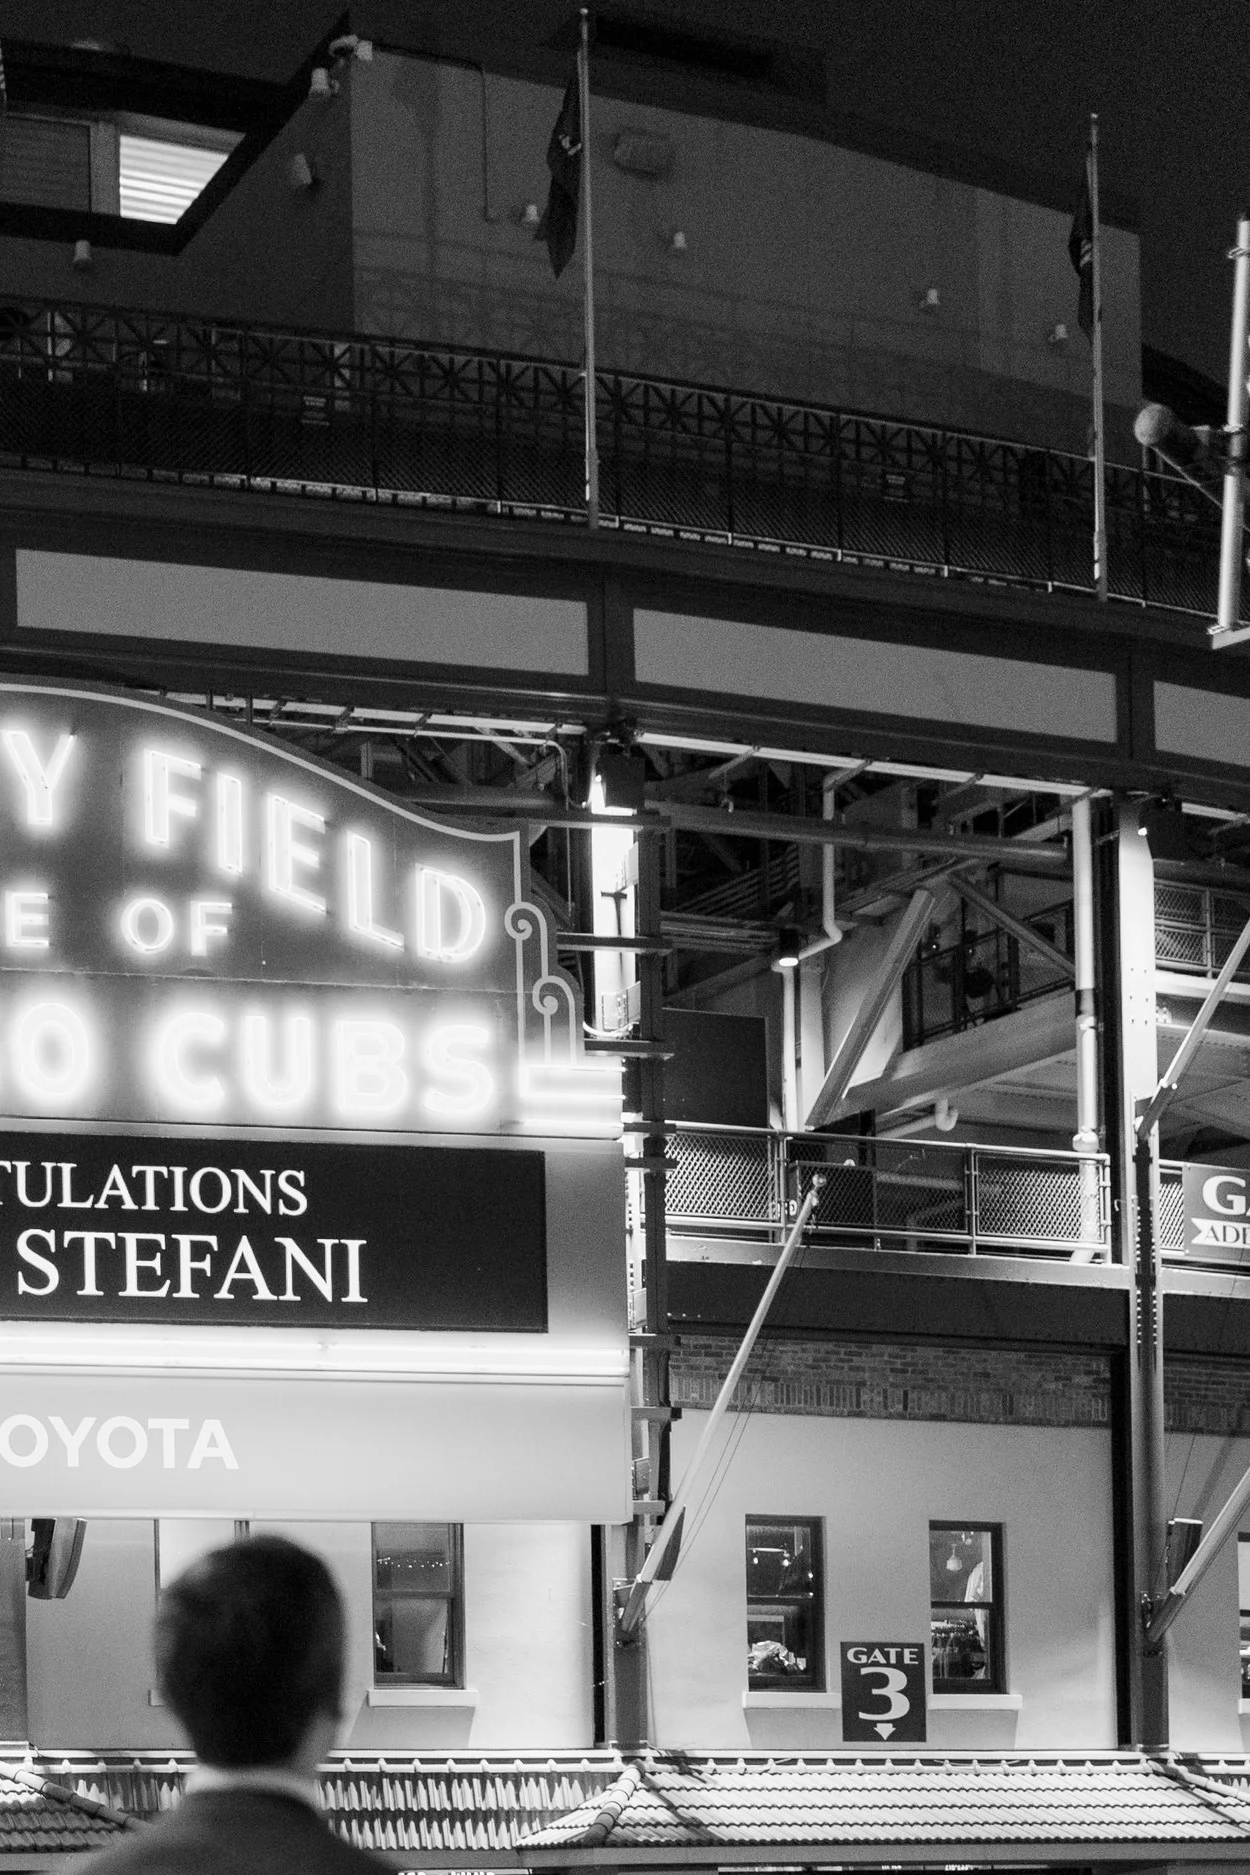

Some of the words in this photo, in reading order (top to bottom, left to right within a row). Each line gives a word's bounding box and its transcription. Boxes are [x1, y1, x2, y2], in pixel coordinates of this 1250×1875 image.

[144, 749, 487, 963] FIELD
[121, 897, 233, 956] OF
[156, 1012, 494, 1115] CUBS
[1203, 1175, 1250, 1216] G
[16, 1228, 369, 1303] STEFANI
[847, 1647, 918, 1664] GATE
[858, 1666, 910, 1721] 3
